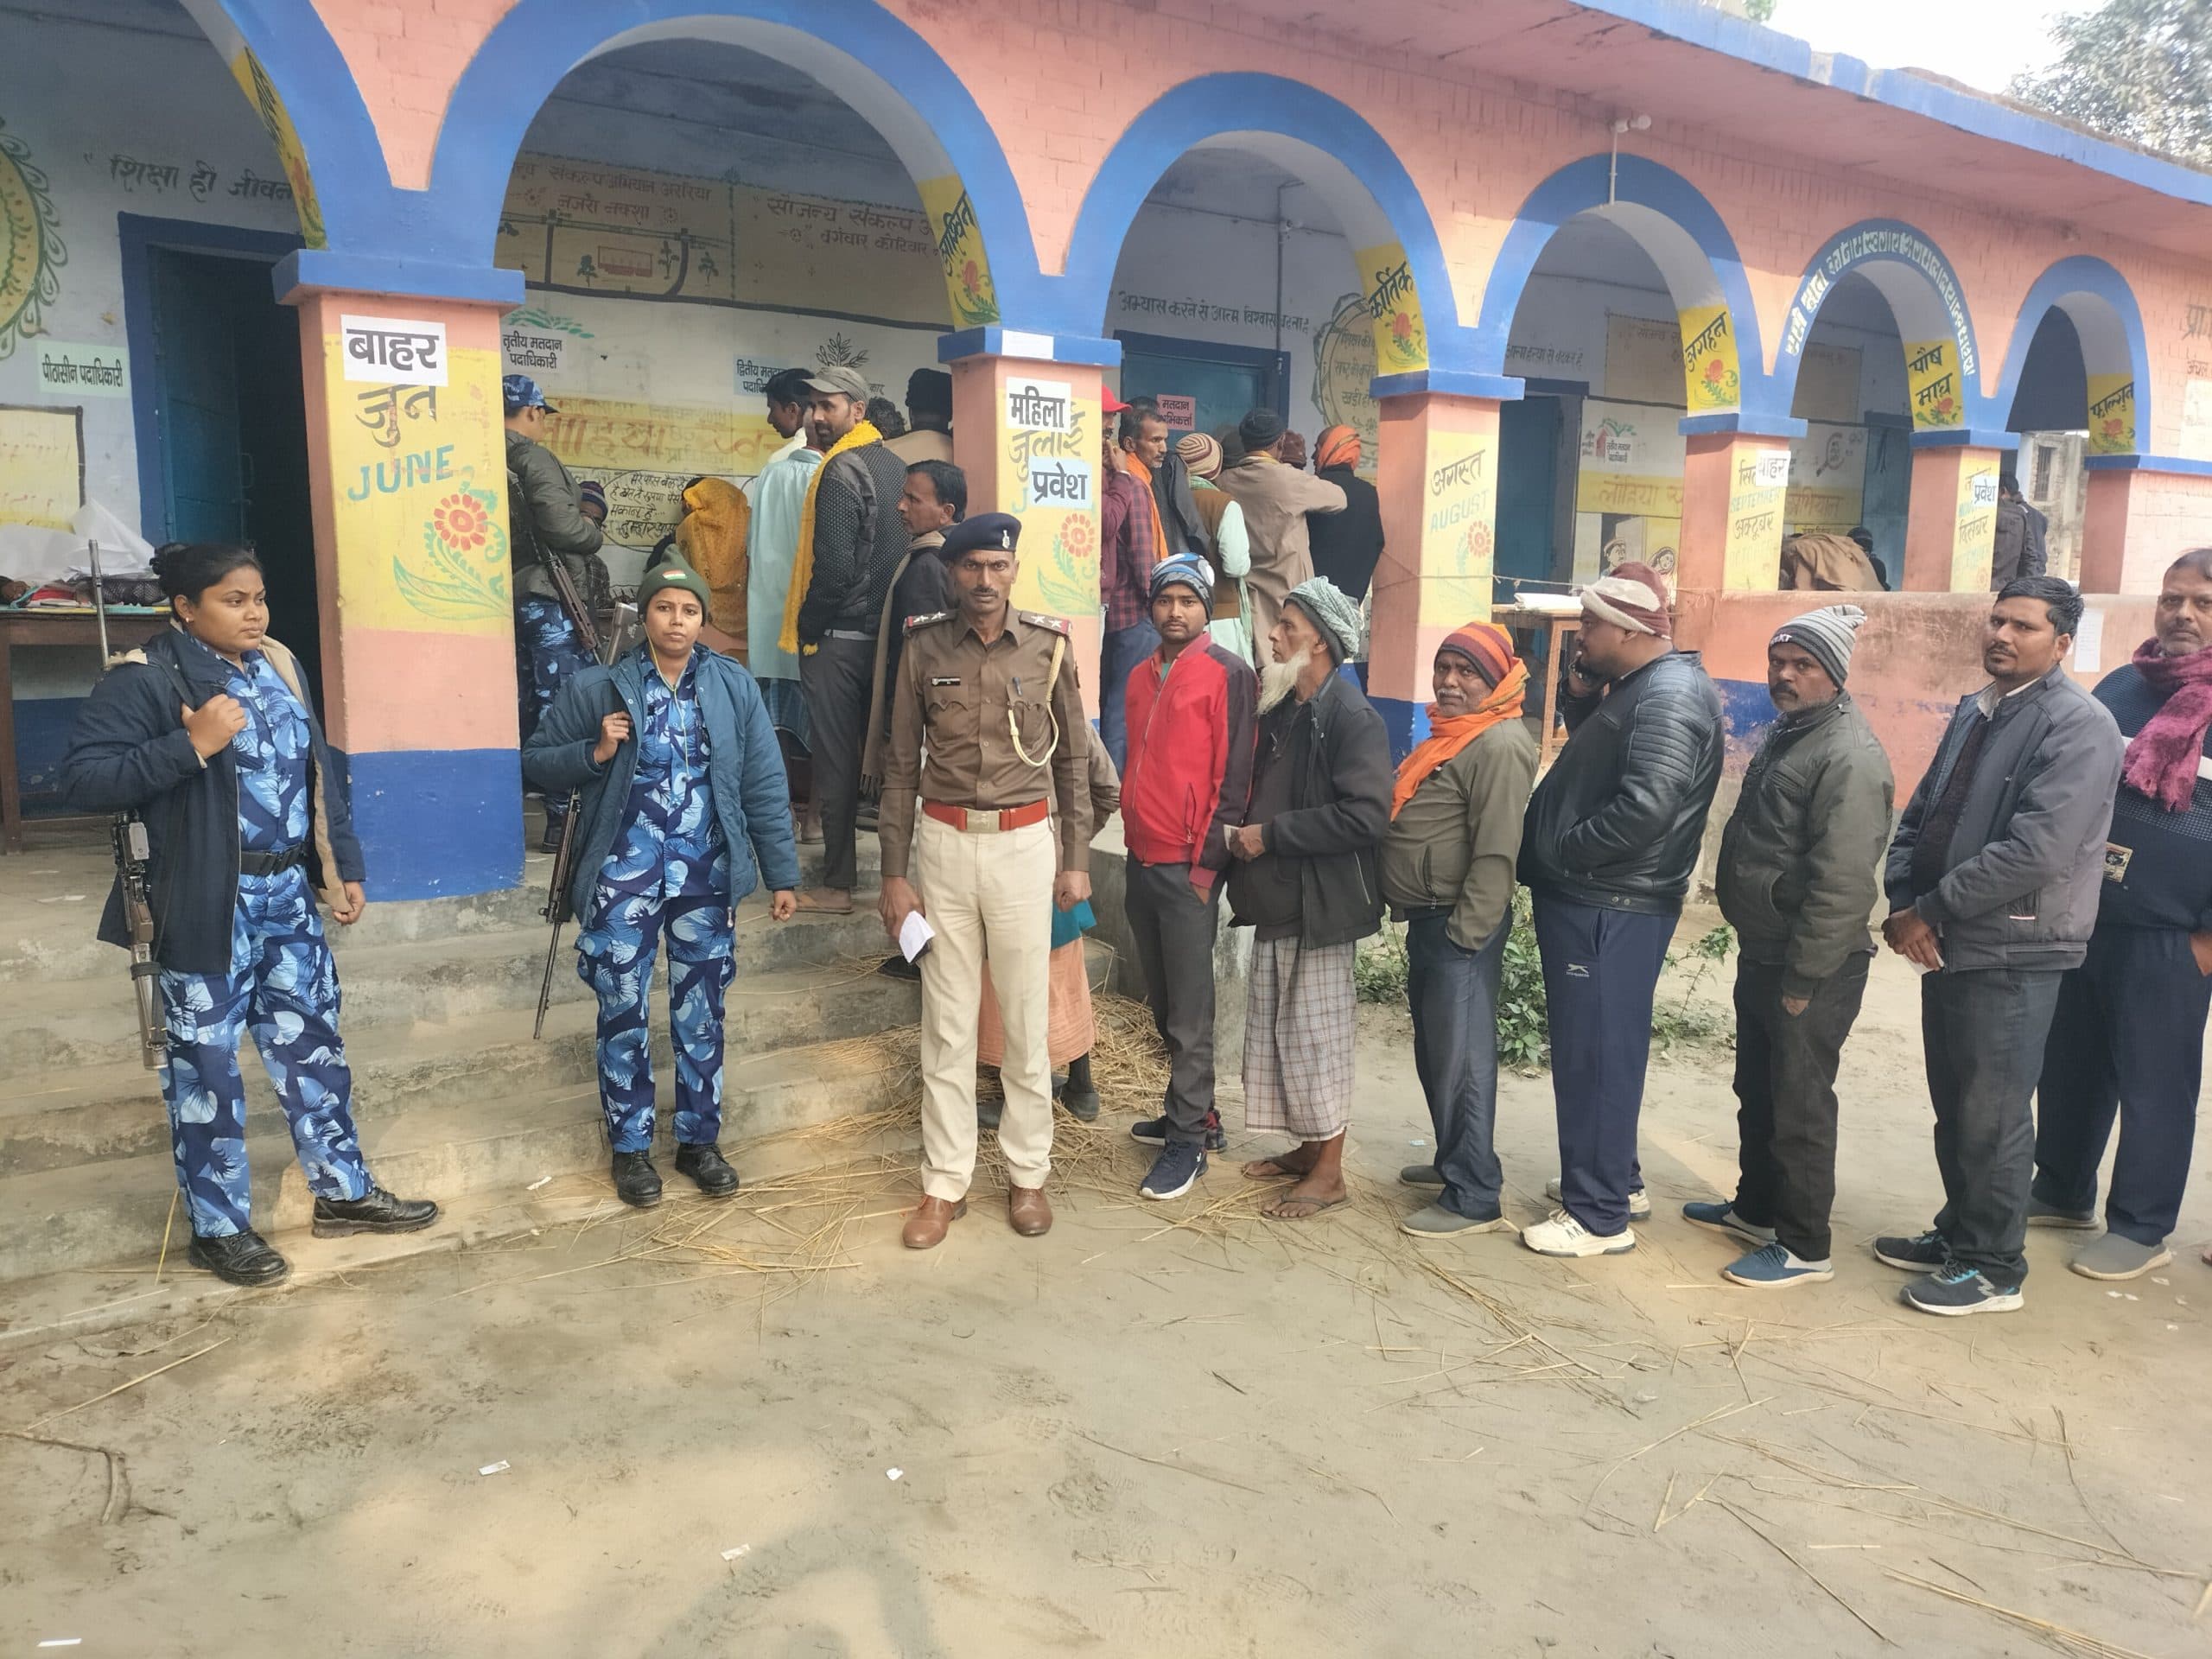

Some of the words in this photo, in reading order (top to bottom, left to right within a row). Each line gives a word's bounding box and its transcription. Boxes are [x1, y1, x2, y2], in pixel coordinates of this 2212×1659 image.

[346, 328, 440, 372] बाहर
[502, 330, 528, 352] तृतीय
[530, 337, 563, 352] मतदान
[1685, 311, 1728, 373] अगहन
[41, 353, 79, 384] पीठासीन
[79, 357, 124, 387] पदाधिकारी
[509, 349, 557, 369] पदाधिकारी
[1908, 345, 1942, 374] पौष
[1161, 399, 1190, 411] मतदान
[1915, 372, 1953, 406] माघ
[1009, 385, 1066, 429] महिला
[347, 444, 454, 501] JUNE
[1032, 462, 1088, 504] प्रवेश
[1431, 448, 1486, 497] अगस्त
[1974, 478, 1997, 504] प्रवेश
